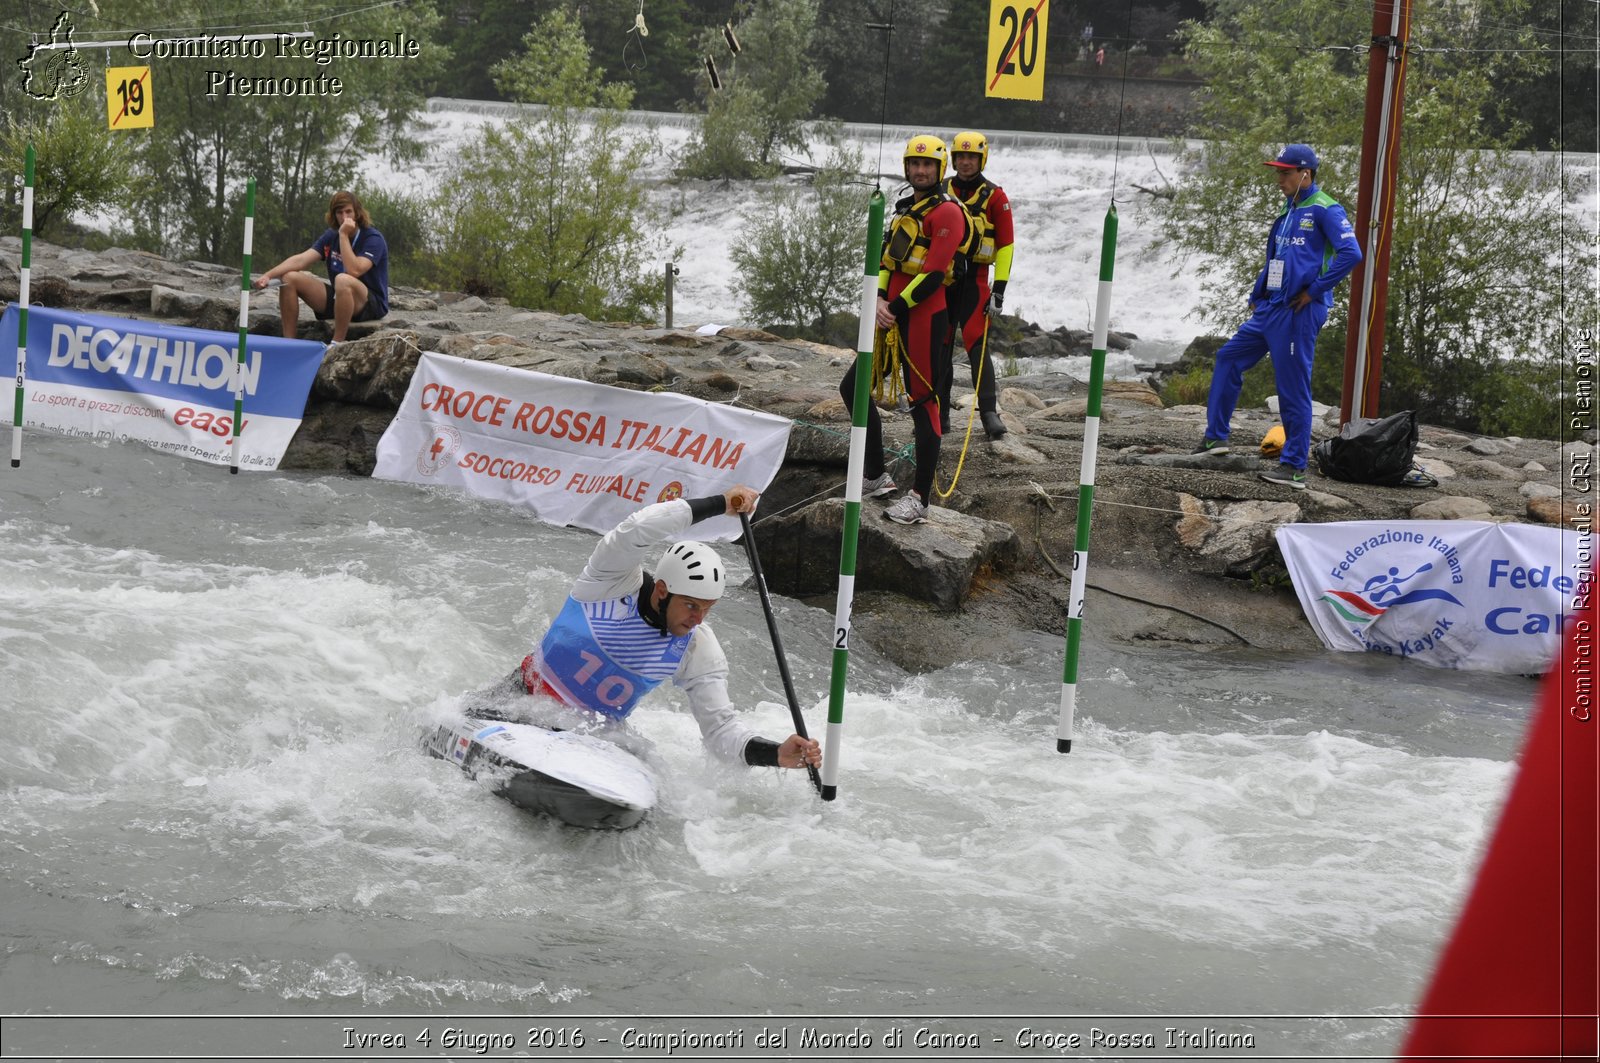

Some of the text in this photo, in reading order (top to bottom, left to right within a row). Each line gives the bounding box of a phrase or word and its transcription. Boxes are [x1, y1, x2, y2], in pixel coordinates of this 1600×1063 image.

[996, 6, 1039, 76] 20
[116, 78, 145, 116] 19
[47, 323, 262, 396] DECATHLON
[31, 391, 166, 420] Lo sport a prezzi discount
[420, 382, 747, 470] CROCE ROSSA ITALIANA
[160, 440, 189, 453] sempre
[189, 445, 220, 461] aperto
[250, 455, 264, 467] alle
[264, 457, 276, 467] 20
[457, 451, 561, 486] SOCCORSO
[1331, 529, 1464, 585] Federazione Italiana
[1400, 617, 1454, 656] Kayak
[573, 649, 634, 707] 10
